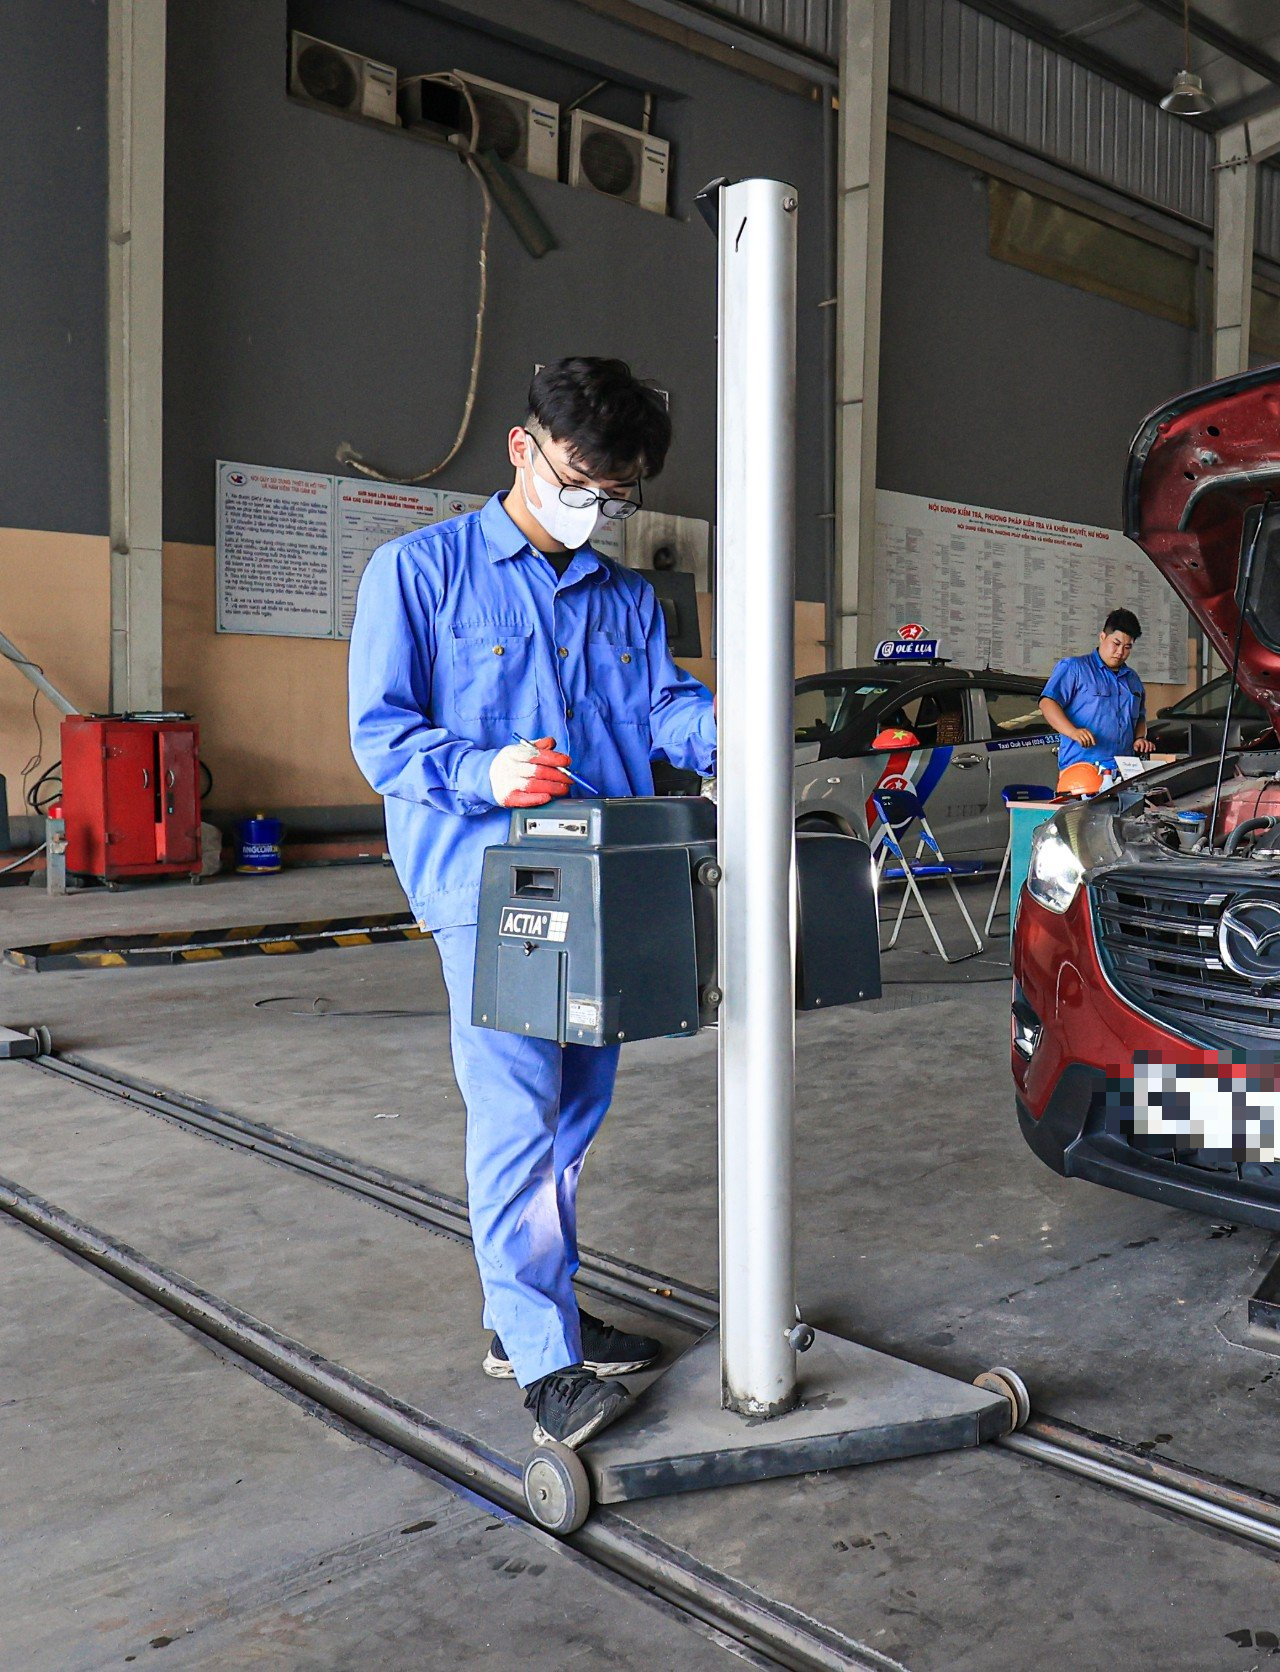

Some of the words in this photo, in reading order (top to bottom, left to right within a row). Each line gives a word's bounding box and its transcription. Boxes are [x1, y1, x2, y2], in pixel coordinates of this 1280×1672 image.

[941, 506, 956, 514] DUNG
[1008, 516, 1022, 524] PHÁP
[1036, 521, 1044, 529] TRA
[1046, 522, 1052, 530] VÀ
